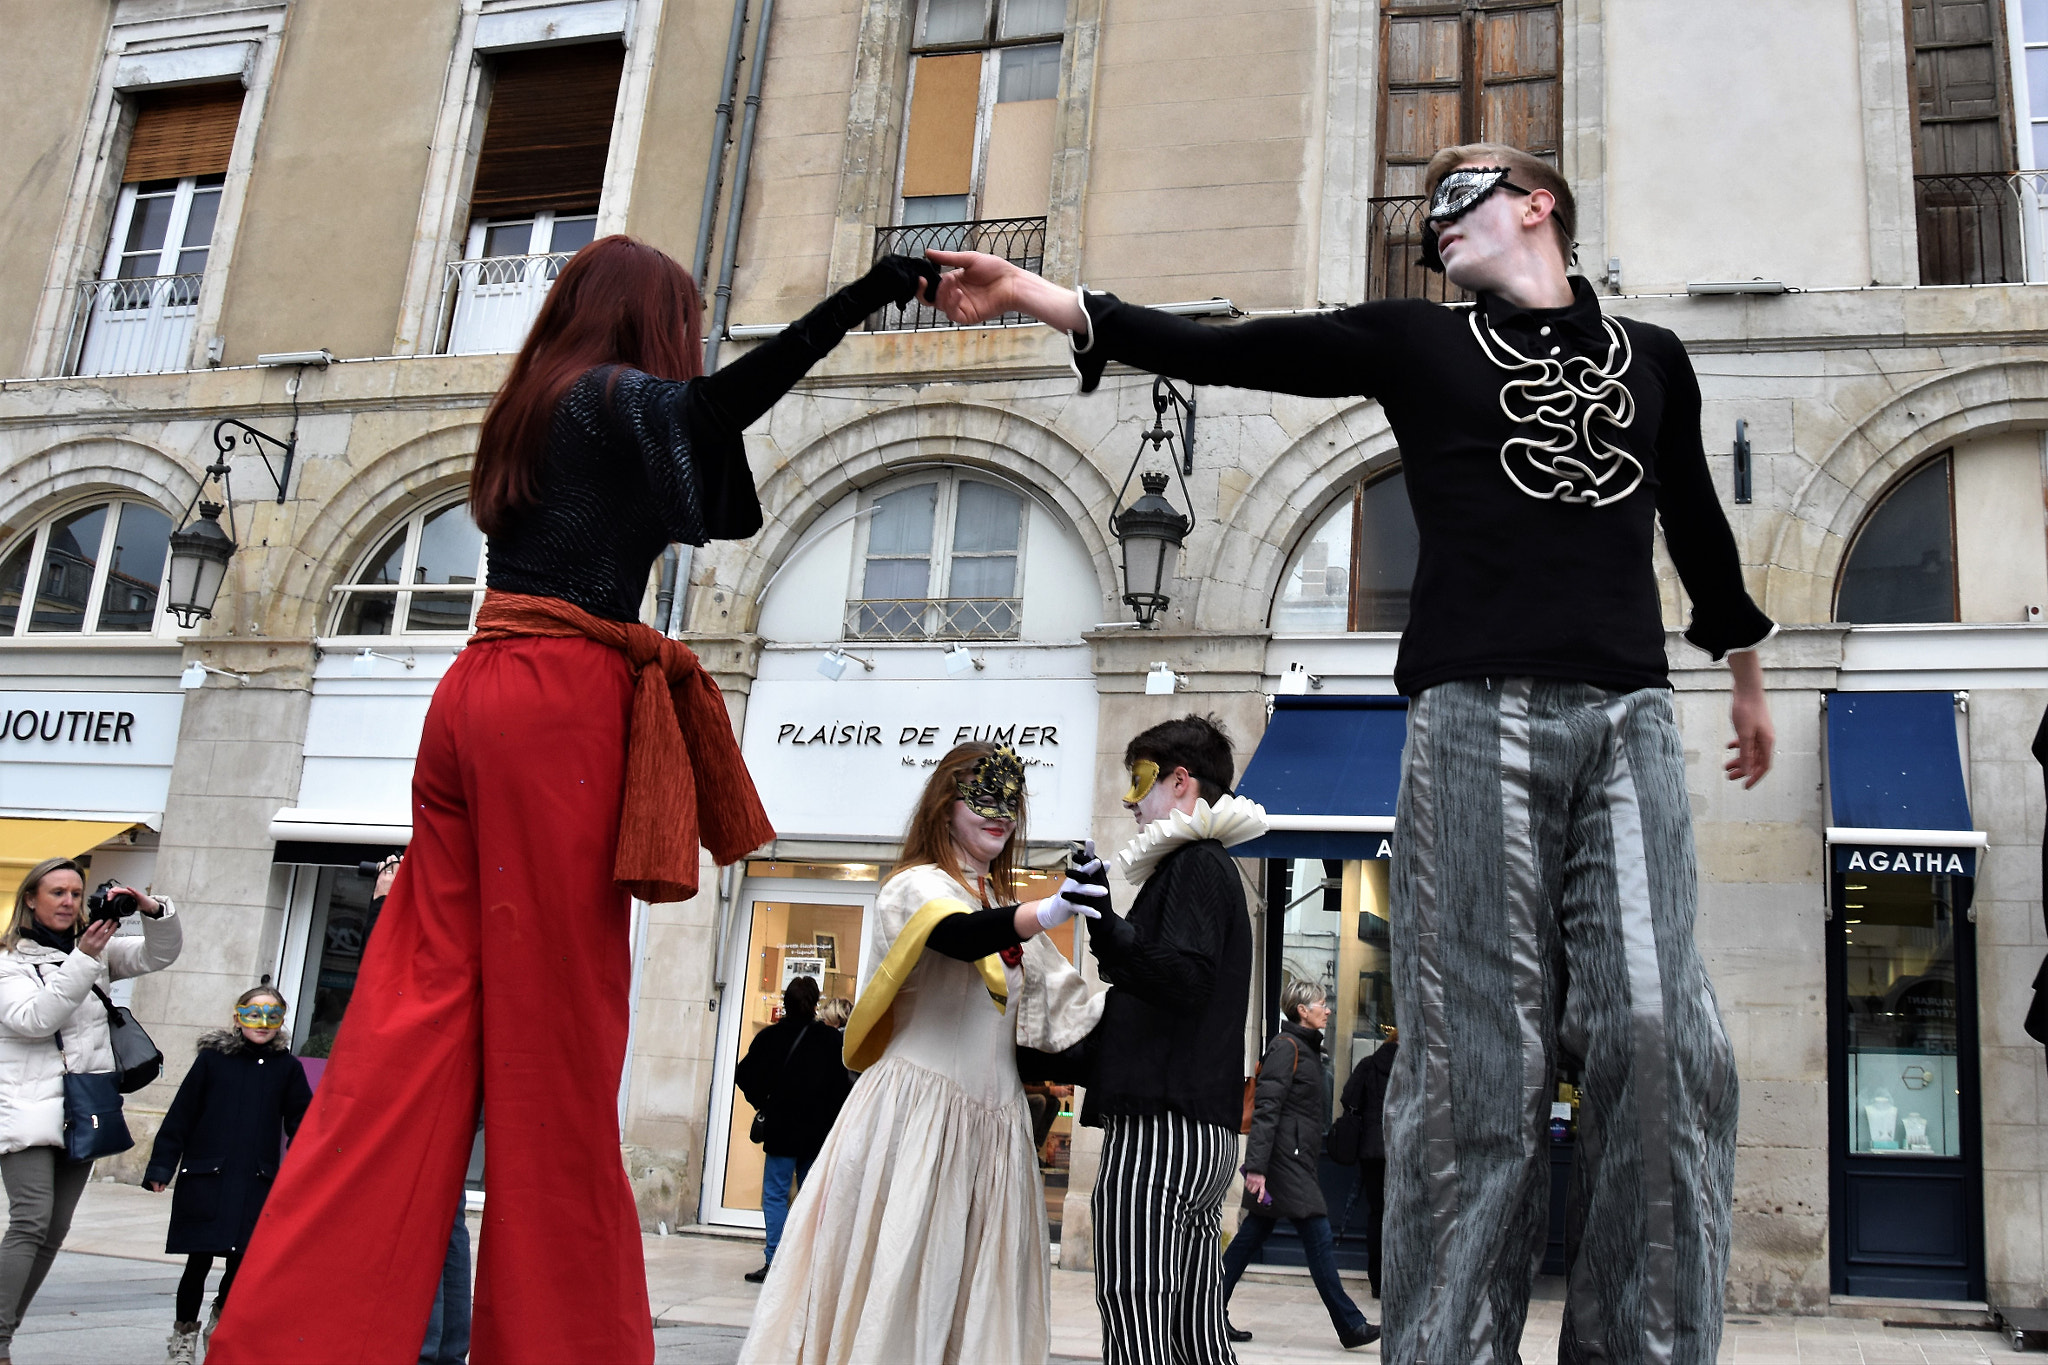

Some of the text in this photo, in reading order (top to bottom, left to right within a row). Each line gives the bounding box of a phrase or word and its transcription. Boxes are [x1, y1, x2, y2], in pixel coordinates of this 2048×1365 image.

[899, 726, 940, 745] DE
[953, 723, 1059, 745] FUMER
[920, 758, 941, 768] gar
[1376, 839, 1393, 858] A
[1848, 851, 1965, 874] AGATHA
